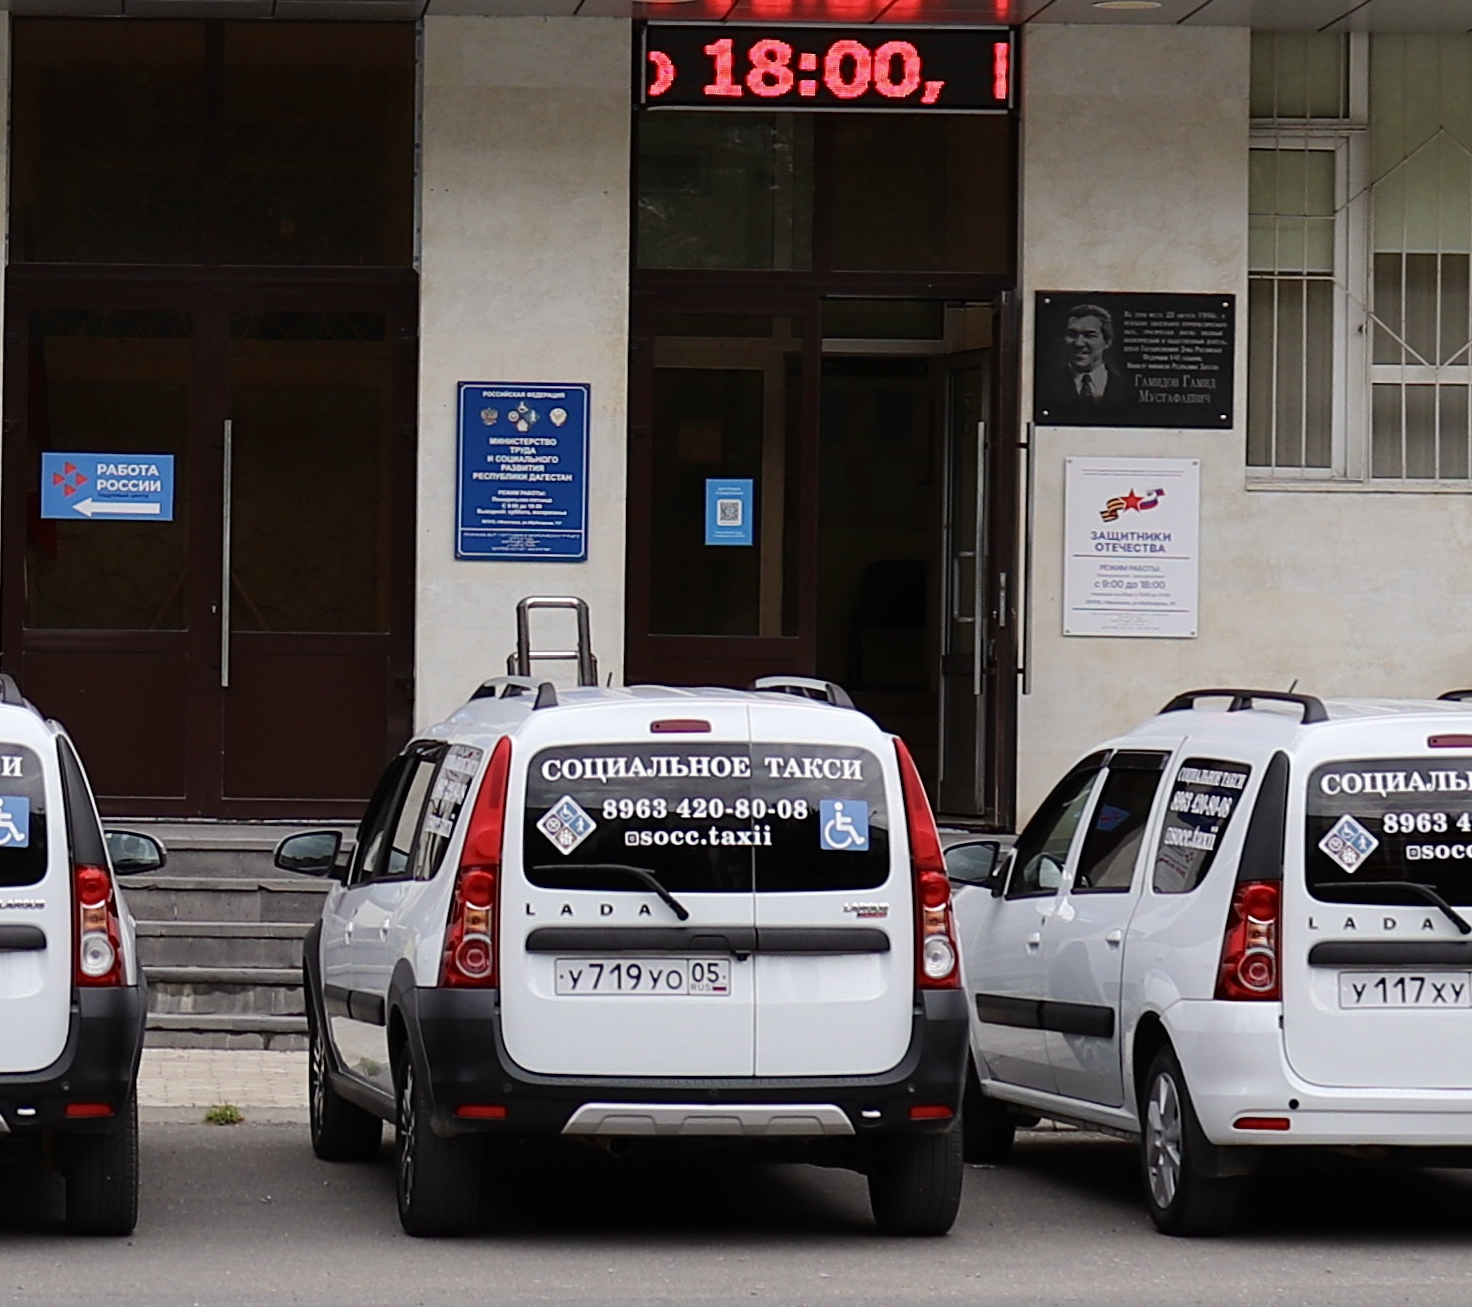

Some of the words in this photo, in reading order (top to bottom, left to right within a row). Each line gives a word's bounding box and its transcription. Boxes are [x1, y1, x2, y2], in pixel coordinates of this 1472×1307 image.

[703, 37, 946, 105] 18:00,
[489, 437, 557, 446] МИНИСТЕРСТВО
[509, 446, 537, 455] ТРУДА
[495, 455, 559, 464] СОЦИАЛЬНОГО
[97, 463, 160, 477] РАБОТА
[500, 464, 545, 472] РАЗВИТИЯ
[472, 472, 528, 481] РЕСПУБЛИКИ
[528, 473, 573, 482] ДАГЕСТАН
[97, 479, 162, 492] РОССИИ
[1090, 530, 1172, 542] ЗАЩИТНИКИ
[1094, 542, 1167, 553] ОТЕЧЕСТВА
[541, 755, 751, 783] СОЦИАЛЬНОЕ
[765, 756, 864, 781] ТАКСИ
[602, 798, 668, 819] 8963
[675, 798, 808, 820] 420-80-08
[1383, 812, 1448, 834] 8963
[525, 903, 652, 917] LADA
[1308, 916, 1435, 930] LADA
[690, 962, 721, 984] 05
